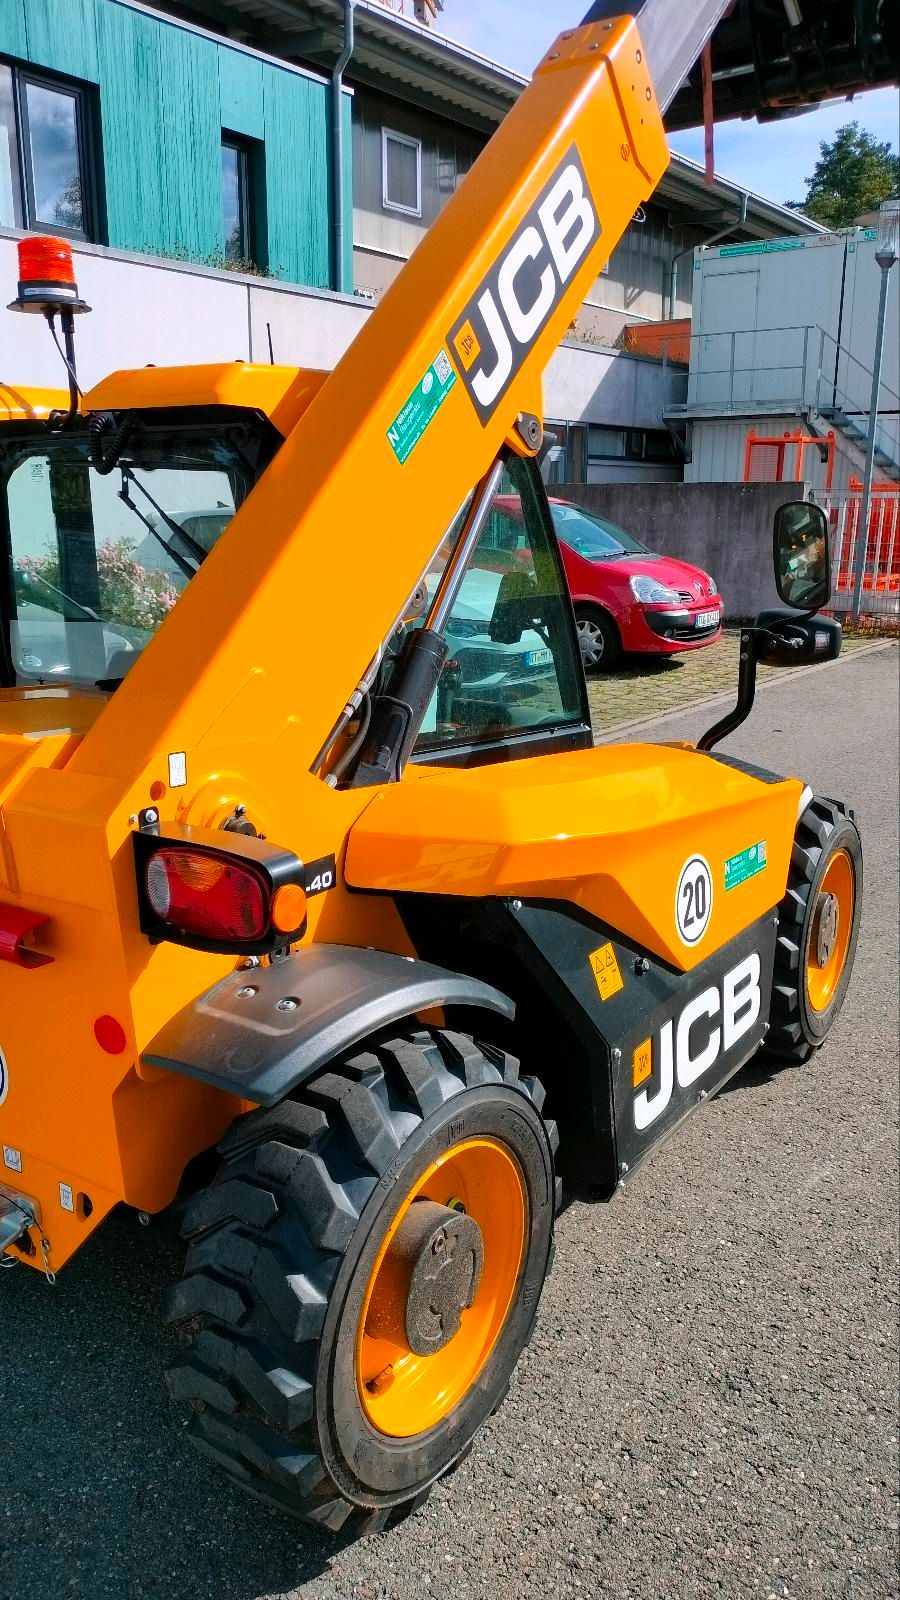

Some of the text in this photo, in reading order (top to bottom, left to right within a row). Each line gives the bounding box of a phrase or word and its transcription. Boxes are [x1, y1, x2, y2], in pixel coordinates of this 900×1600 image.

[471, 164, 595, 407] JCB
[460, 335, 474, 356] JCB
[387, 425, 400, 448] N
[682, 874, 707, 929] 20
[634, 952, 761, 1131] JCB
